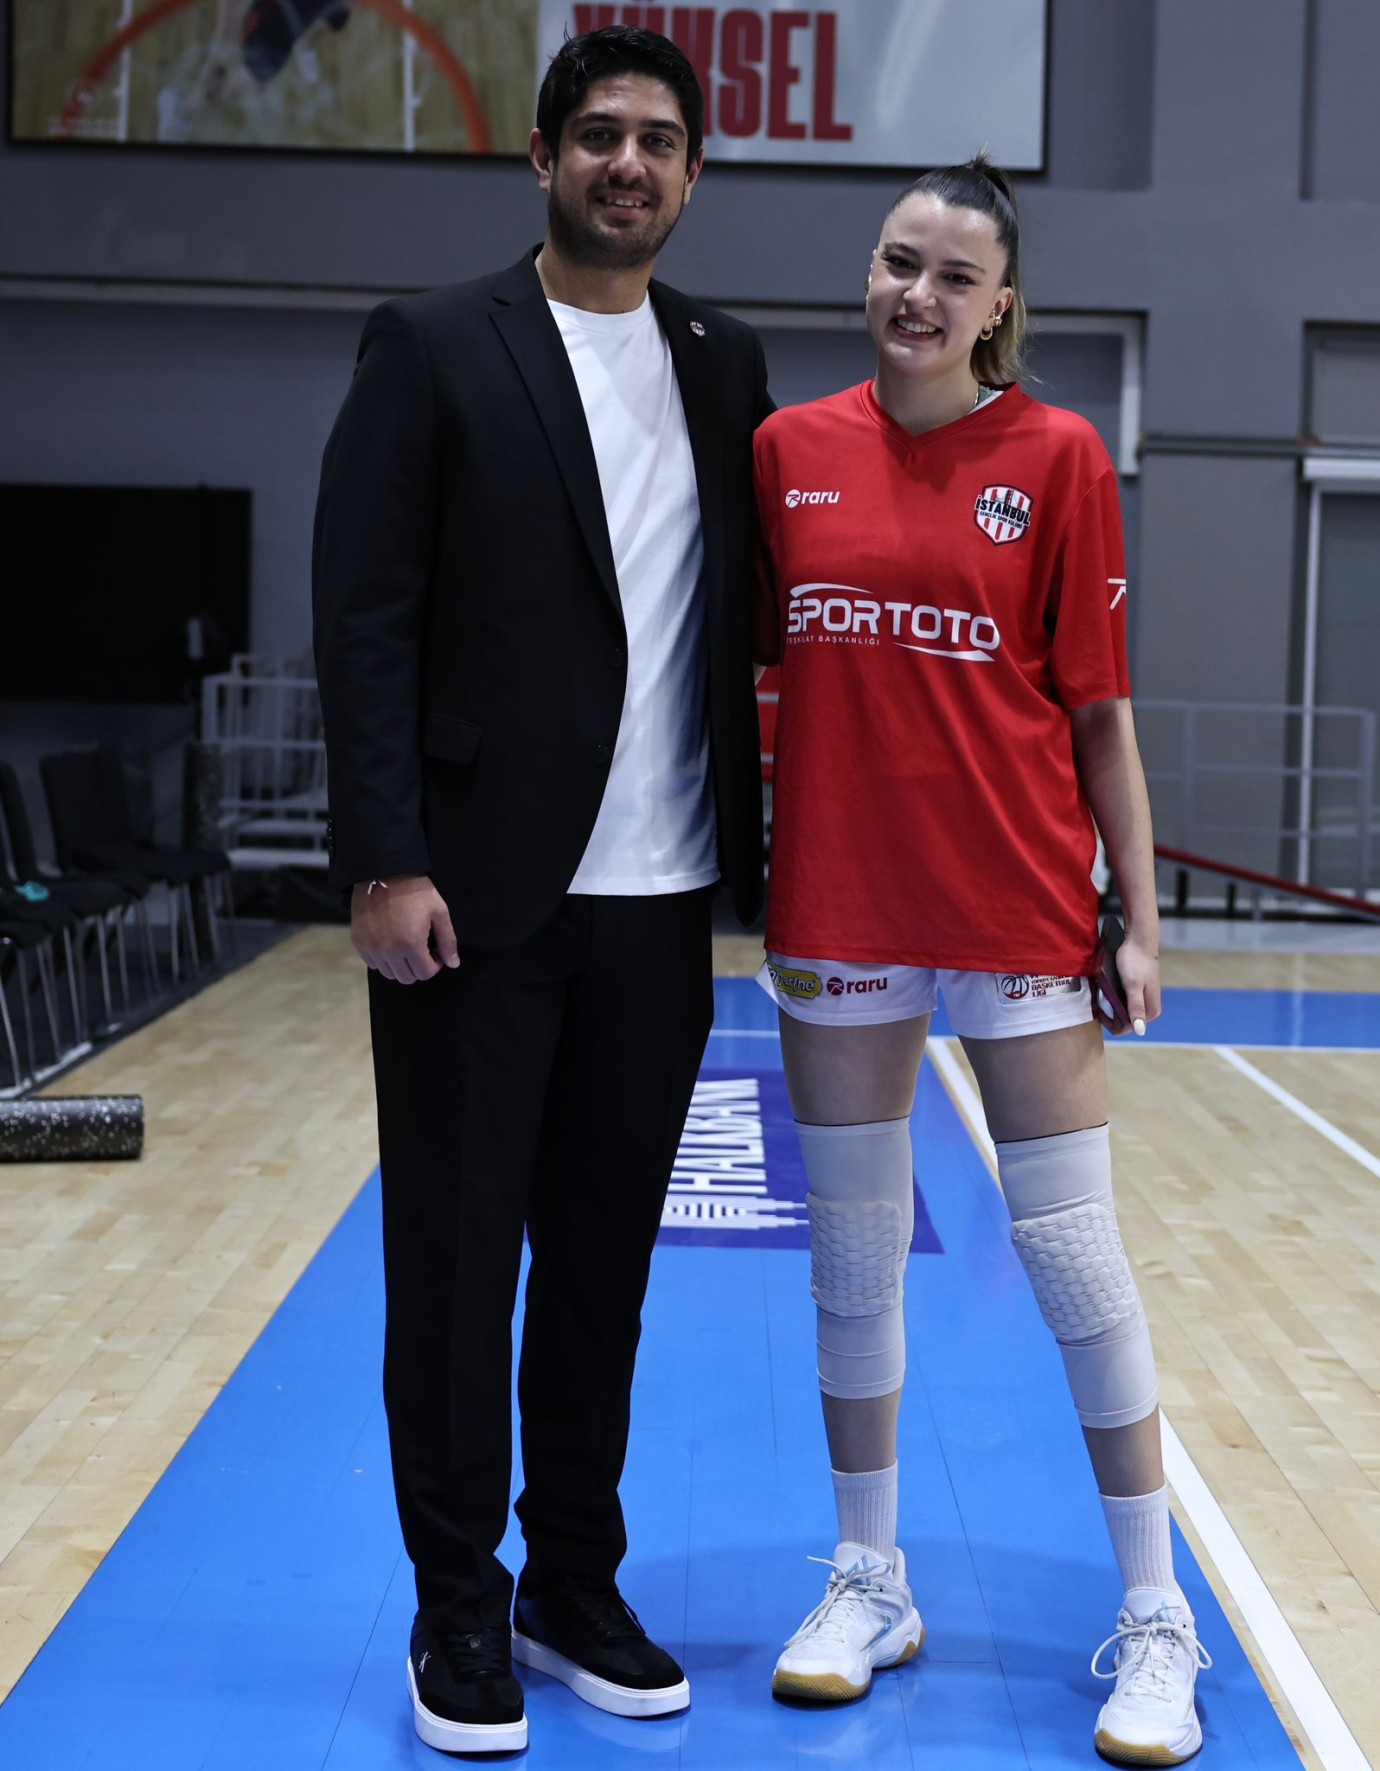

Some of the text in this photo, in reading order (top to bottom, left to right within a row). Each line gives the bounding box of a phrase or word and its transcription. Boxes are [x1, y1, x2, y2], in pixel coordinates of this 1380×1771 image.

[573, 0, 853, 142] KSEL
[801, 491, 840, 504] raru
[976, 495, 1030, 525] İSTANBUL
[818, 635, 880, 645] BAŞKANLIĞI
[846, 977, 888, 994] raru
